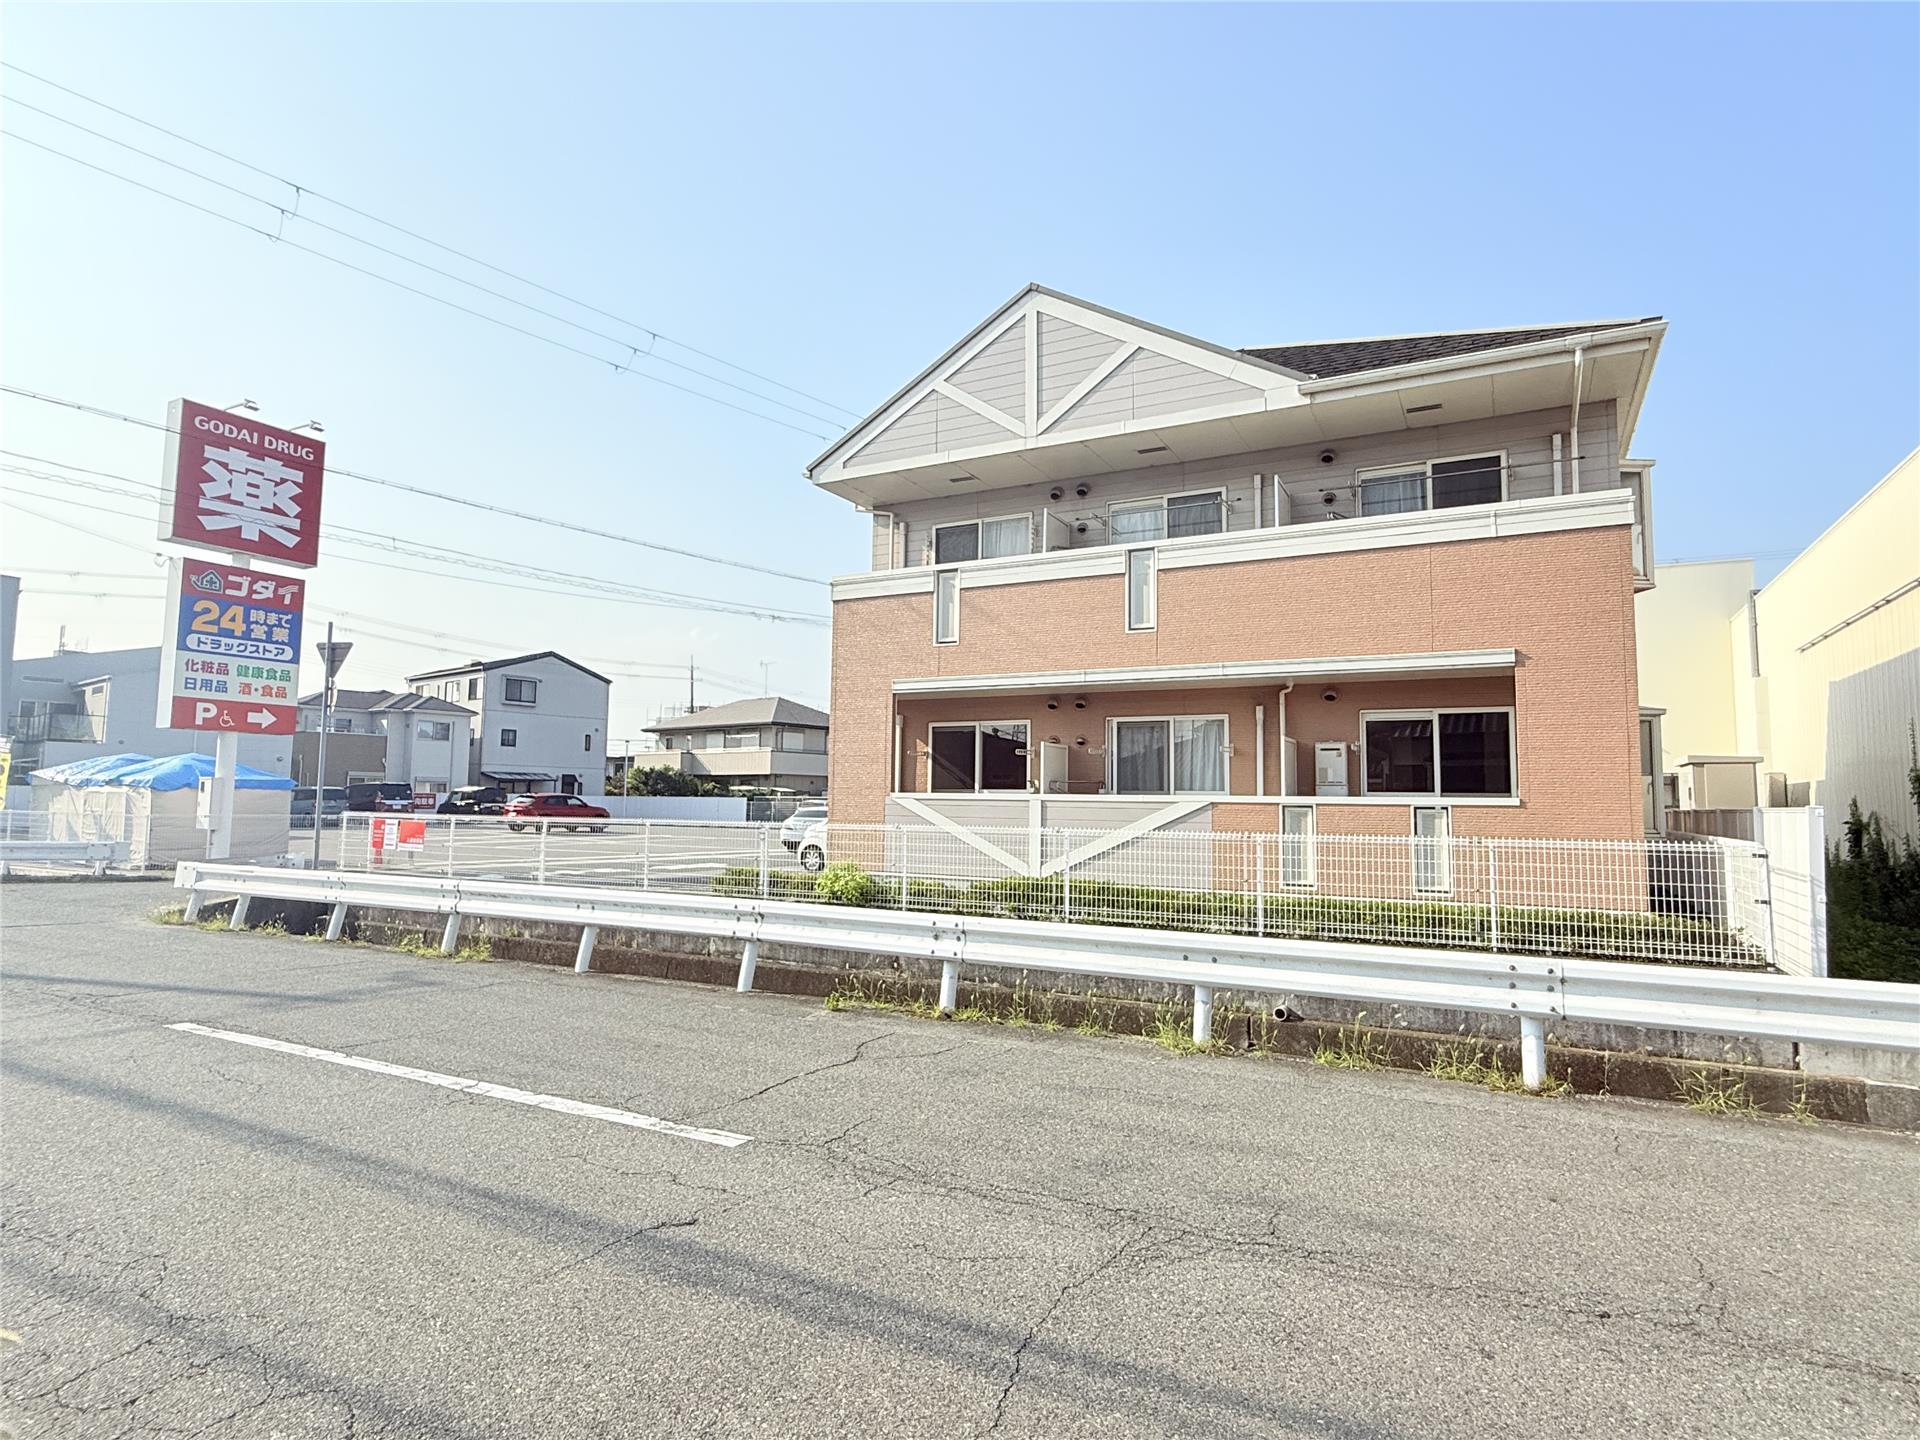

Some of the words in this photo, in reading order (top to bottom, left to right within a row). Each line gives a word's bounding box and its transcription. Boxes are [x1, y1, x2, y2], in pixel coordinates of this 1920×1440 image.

[194, 416, 258, 444] GODAI
[264, 437, 314, 460] DRUG
[197, 445, 303, 548] 薬
[225, 574, 299, 604] ゴダイ
[250, 625, 289, 643] 営業
[196, 637, 285, 657] ドラッグストア
[185, 658, 229, 676] 化粧品
[236, 664, 291, 682] 健康食品
[184, 678, 228, 693] 日用品
[195, 702, 217, 725] P
